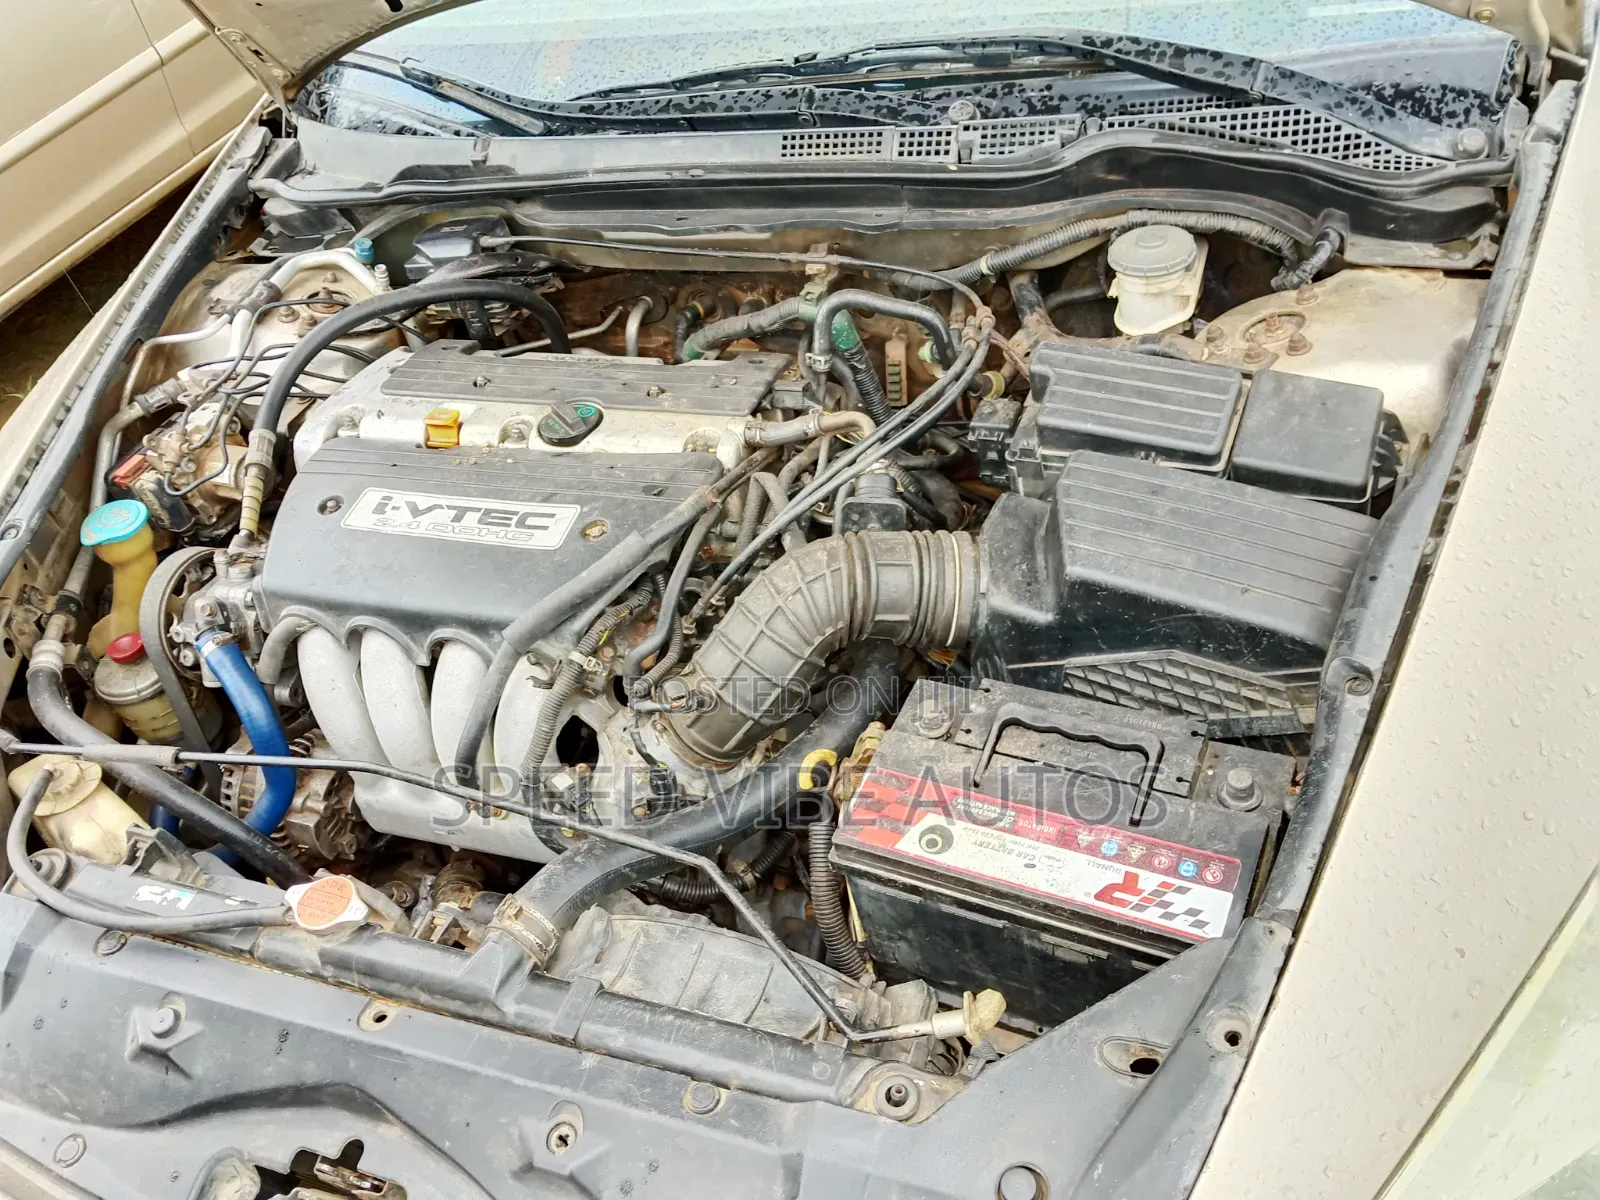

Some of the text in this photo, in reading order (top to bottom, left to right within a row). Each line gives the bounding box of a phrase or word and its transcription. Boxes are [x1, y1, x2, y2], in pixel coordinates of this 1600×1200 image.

[372, 496, 557, 531] i-VTEC
[373, 517, 534, 542] 2.4 DOHC
[971, 838, 1014, 856] BATTERY
[1015, 850, 1036, 861] CAR
[1085, 858, 1122, 874] RUNALL
